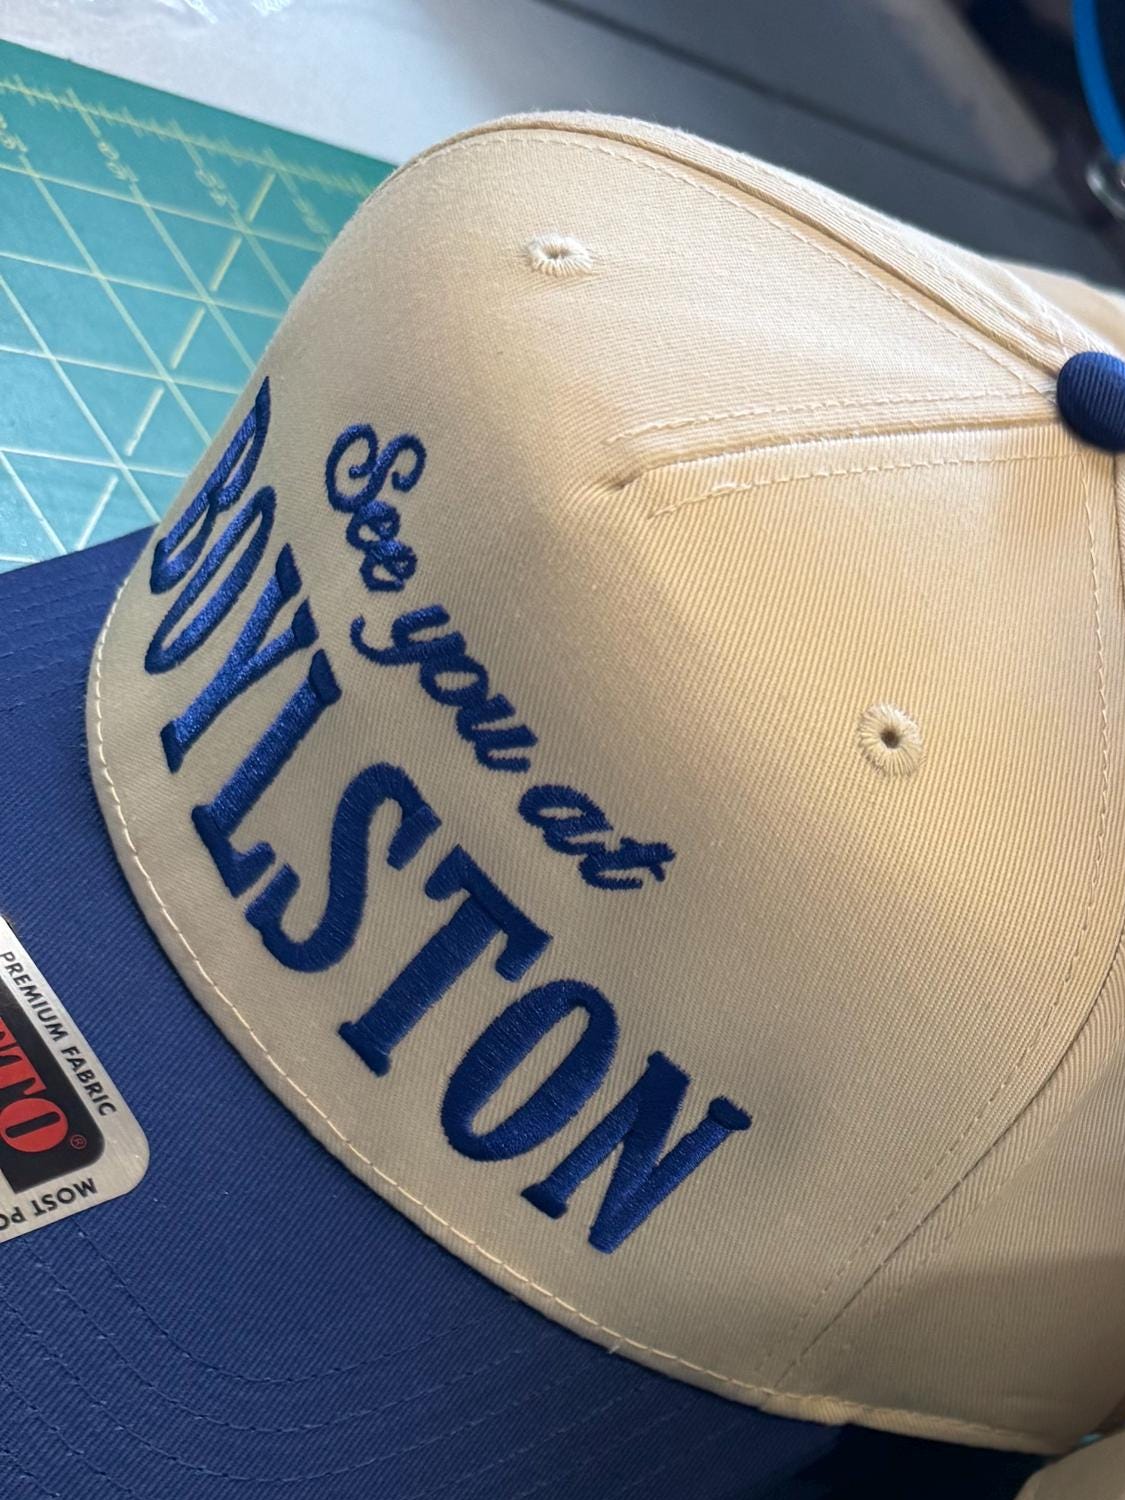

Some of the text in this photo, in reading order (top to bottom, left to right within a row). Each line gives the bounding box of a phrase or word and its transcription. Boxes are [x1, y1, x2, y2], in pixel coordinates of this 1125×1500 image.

[143, 376, 752, 1255] BOYLSTON
[324, 423, 675, 892] See you at
[0, 951, 117, 1117] PREMIUM FABRIC
[30, 1177, 98, 1217] MOST
